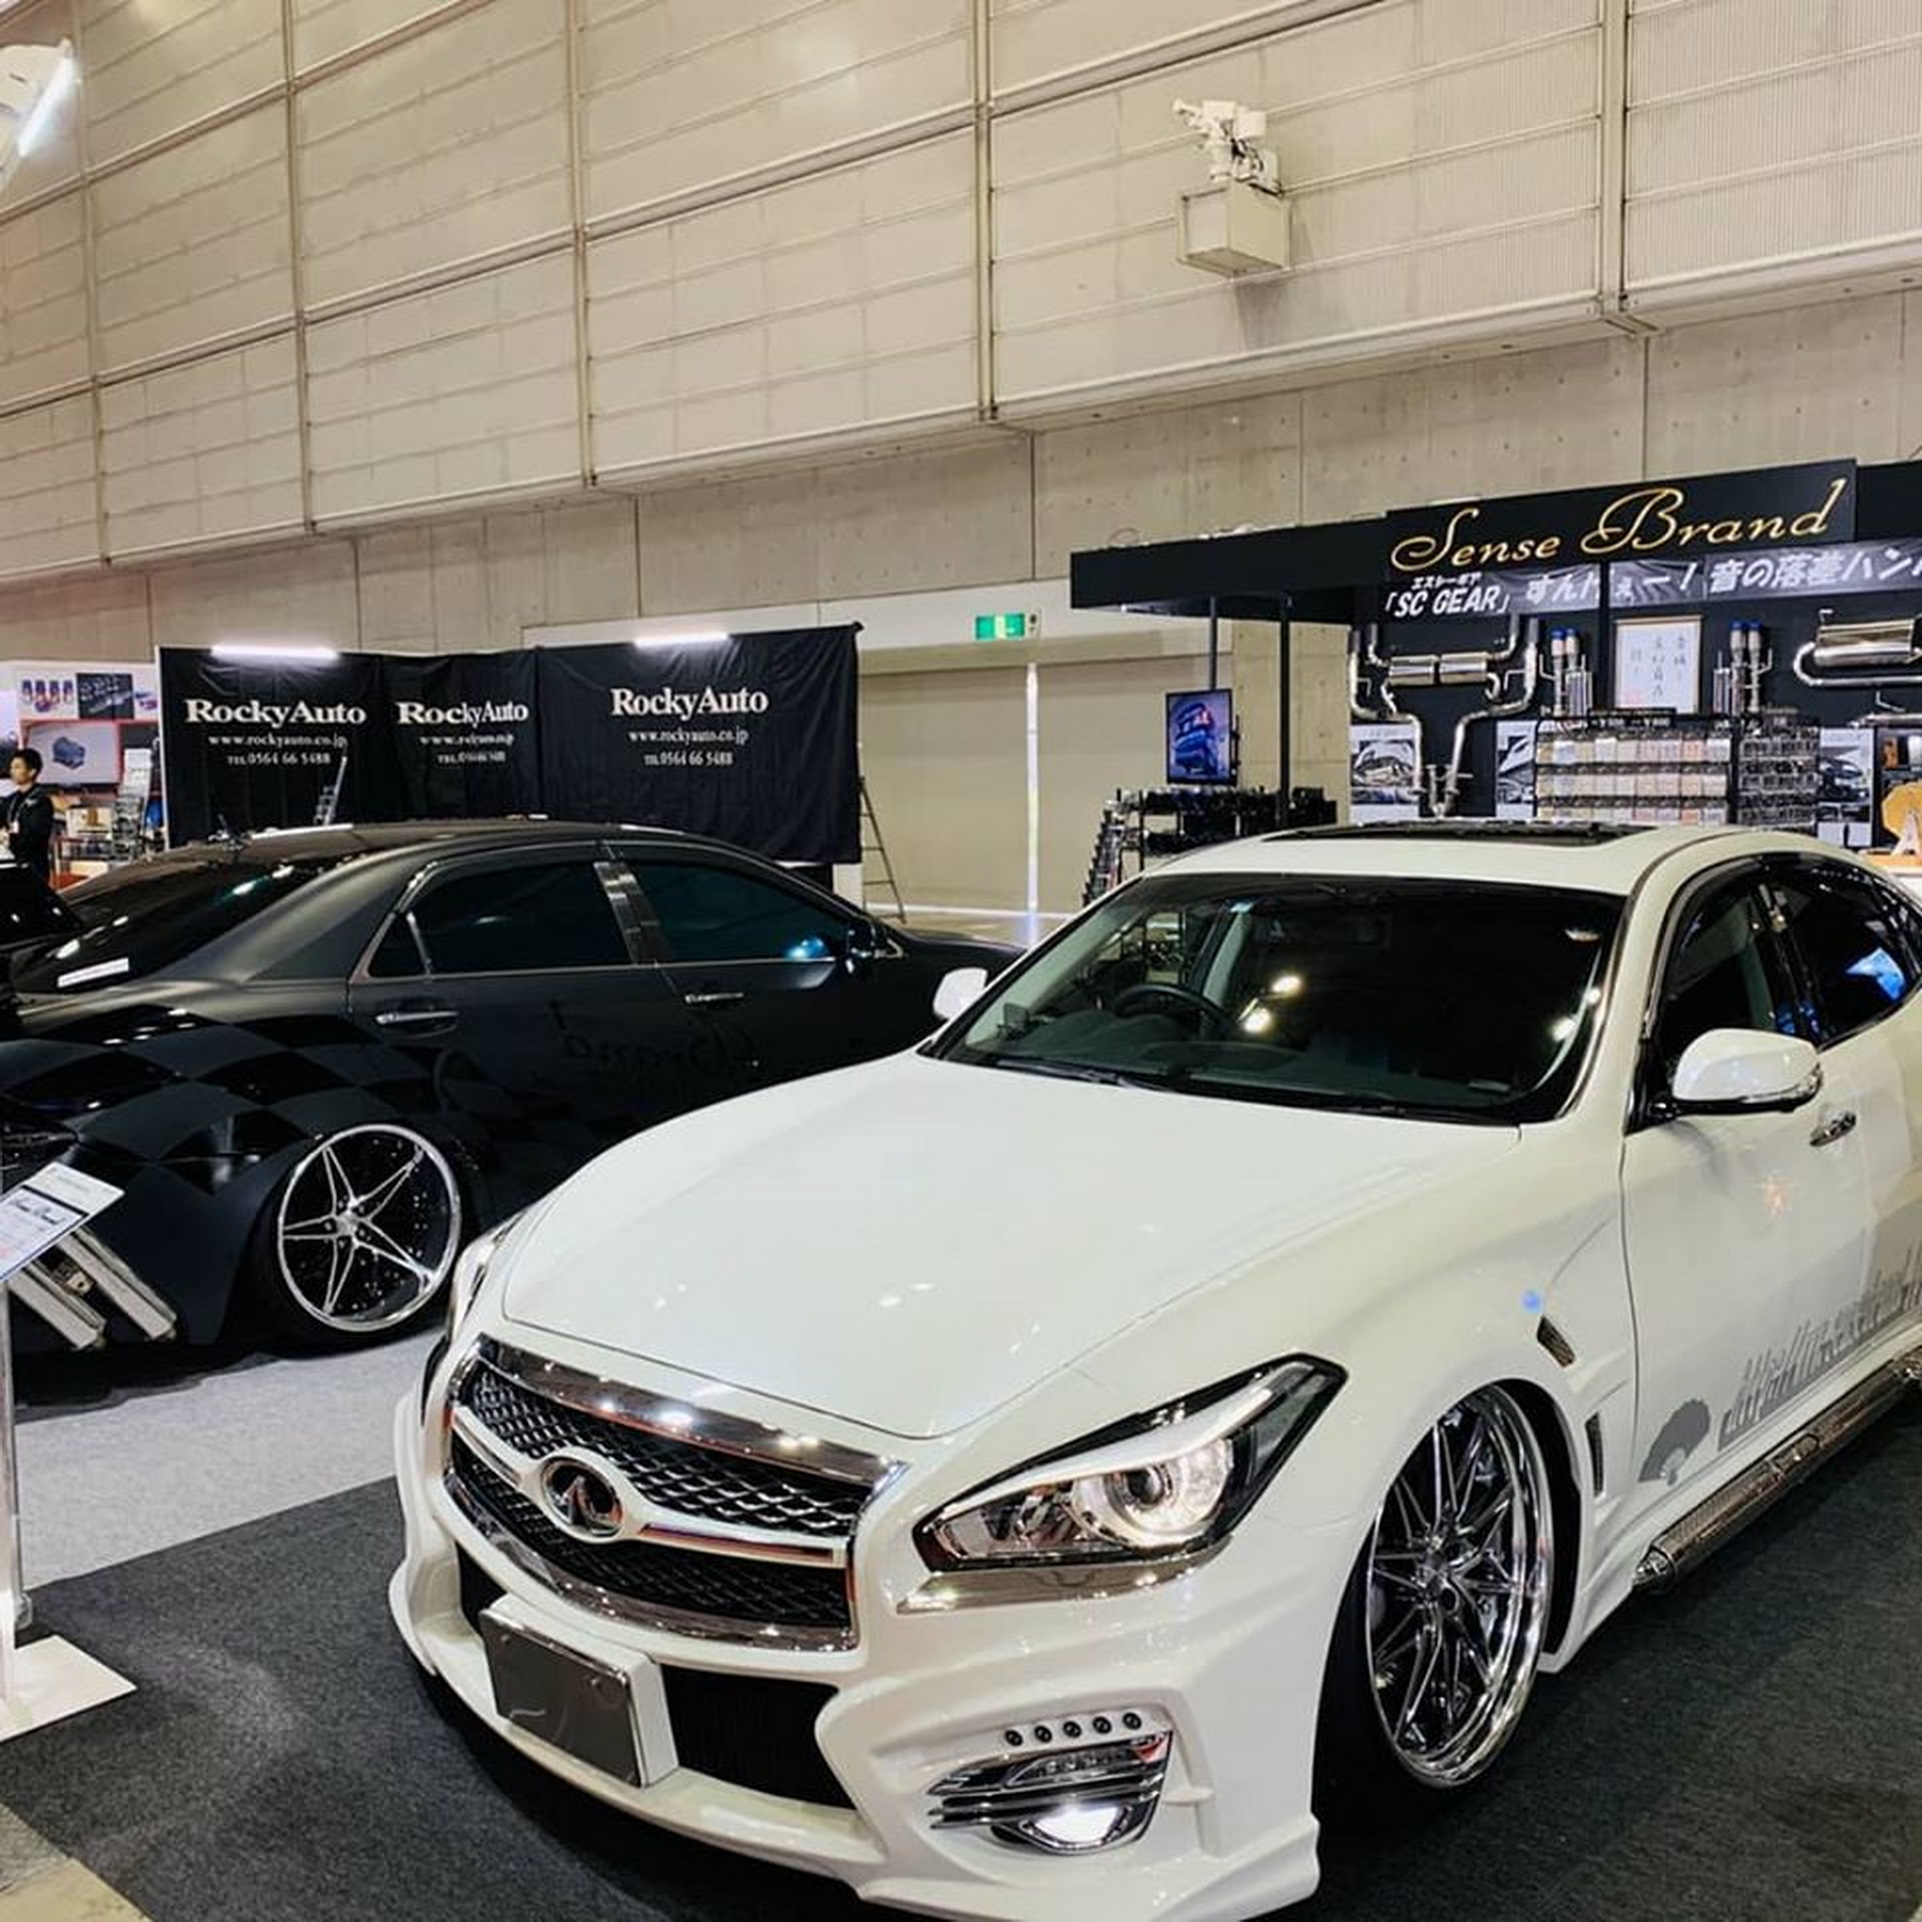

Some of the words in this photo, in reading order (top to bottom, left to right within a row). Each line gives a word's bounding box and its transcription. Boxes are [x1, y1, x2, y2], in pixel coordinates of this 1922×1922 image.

[1391, 508, 1560, 571] Sense
[1580, 478, 1847, 554] Brand
[185, 699, 367, 729] RockyAuto
[395, 700, 529, 729] RockyAuto
[609, 685, 769, 721] RockyAuto
